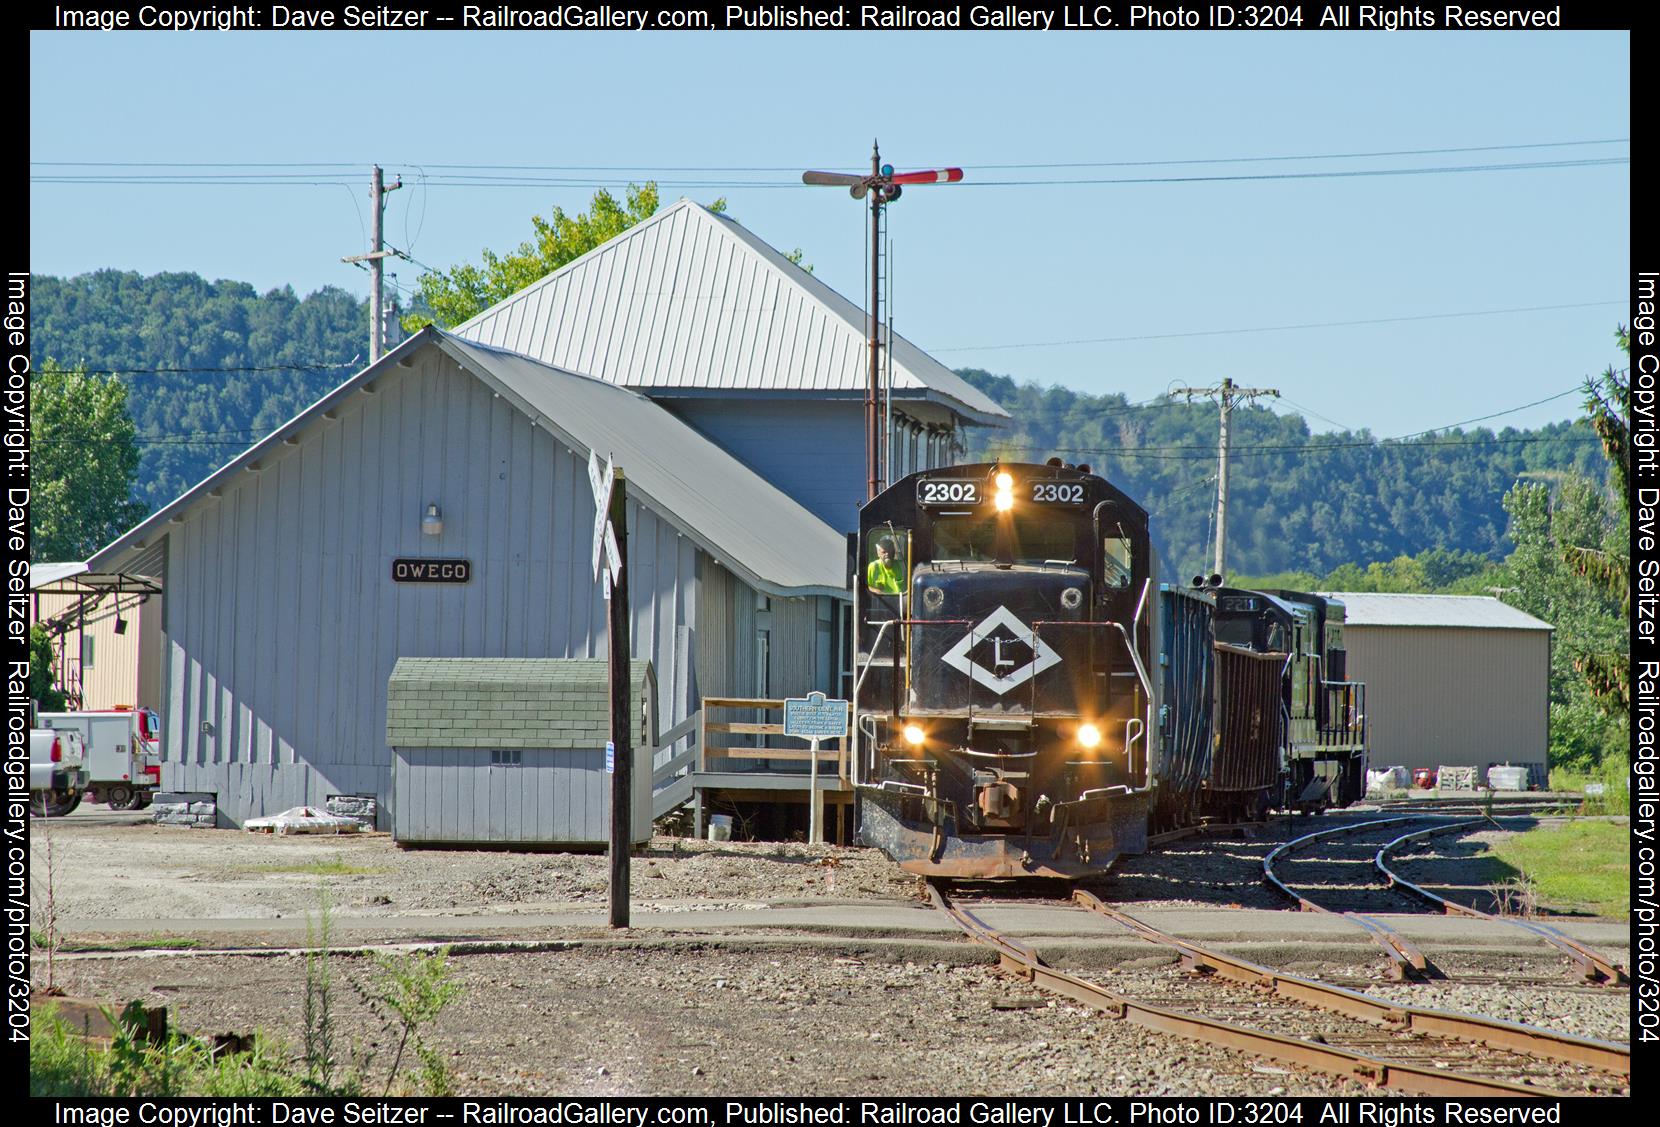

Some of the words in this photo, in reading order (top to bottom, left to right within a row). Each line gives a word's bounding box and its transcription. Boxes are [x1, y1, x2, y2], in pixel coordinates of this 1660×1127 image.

[924, 483, 976, 502] 2302
[1033, 484, 1084, 502] 2302
[396, 563, 466, 579] OWEGO
[994, 636, 1015, 666] L
